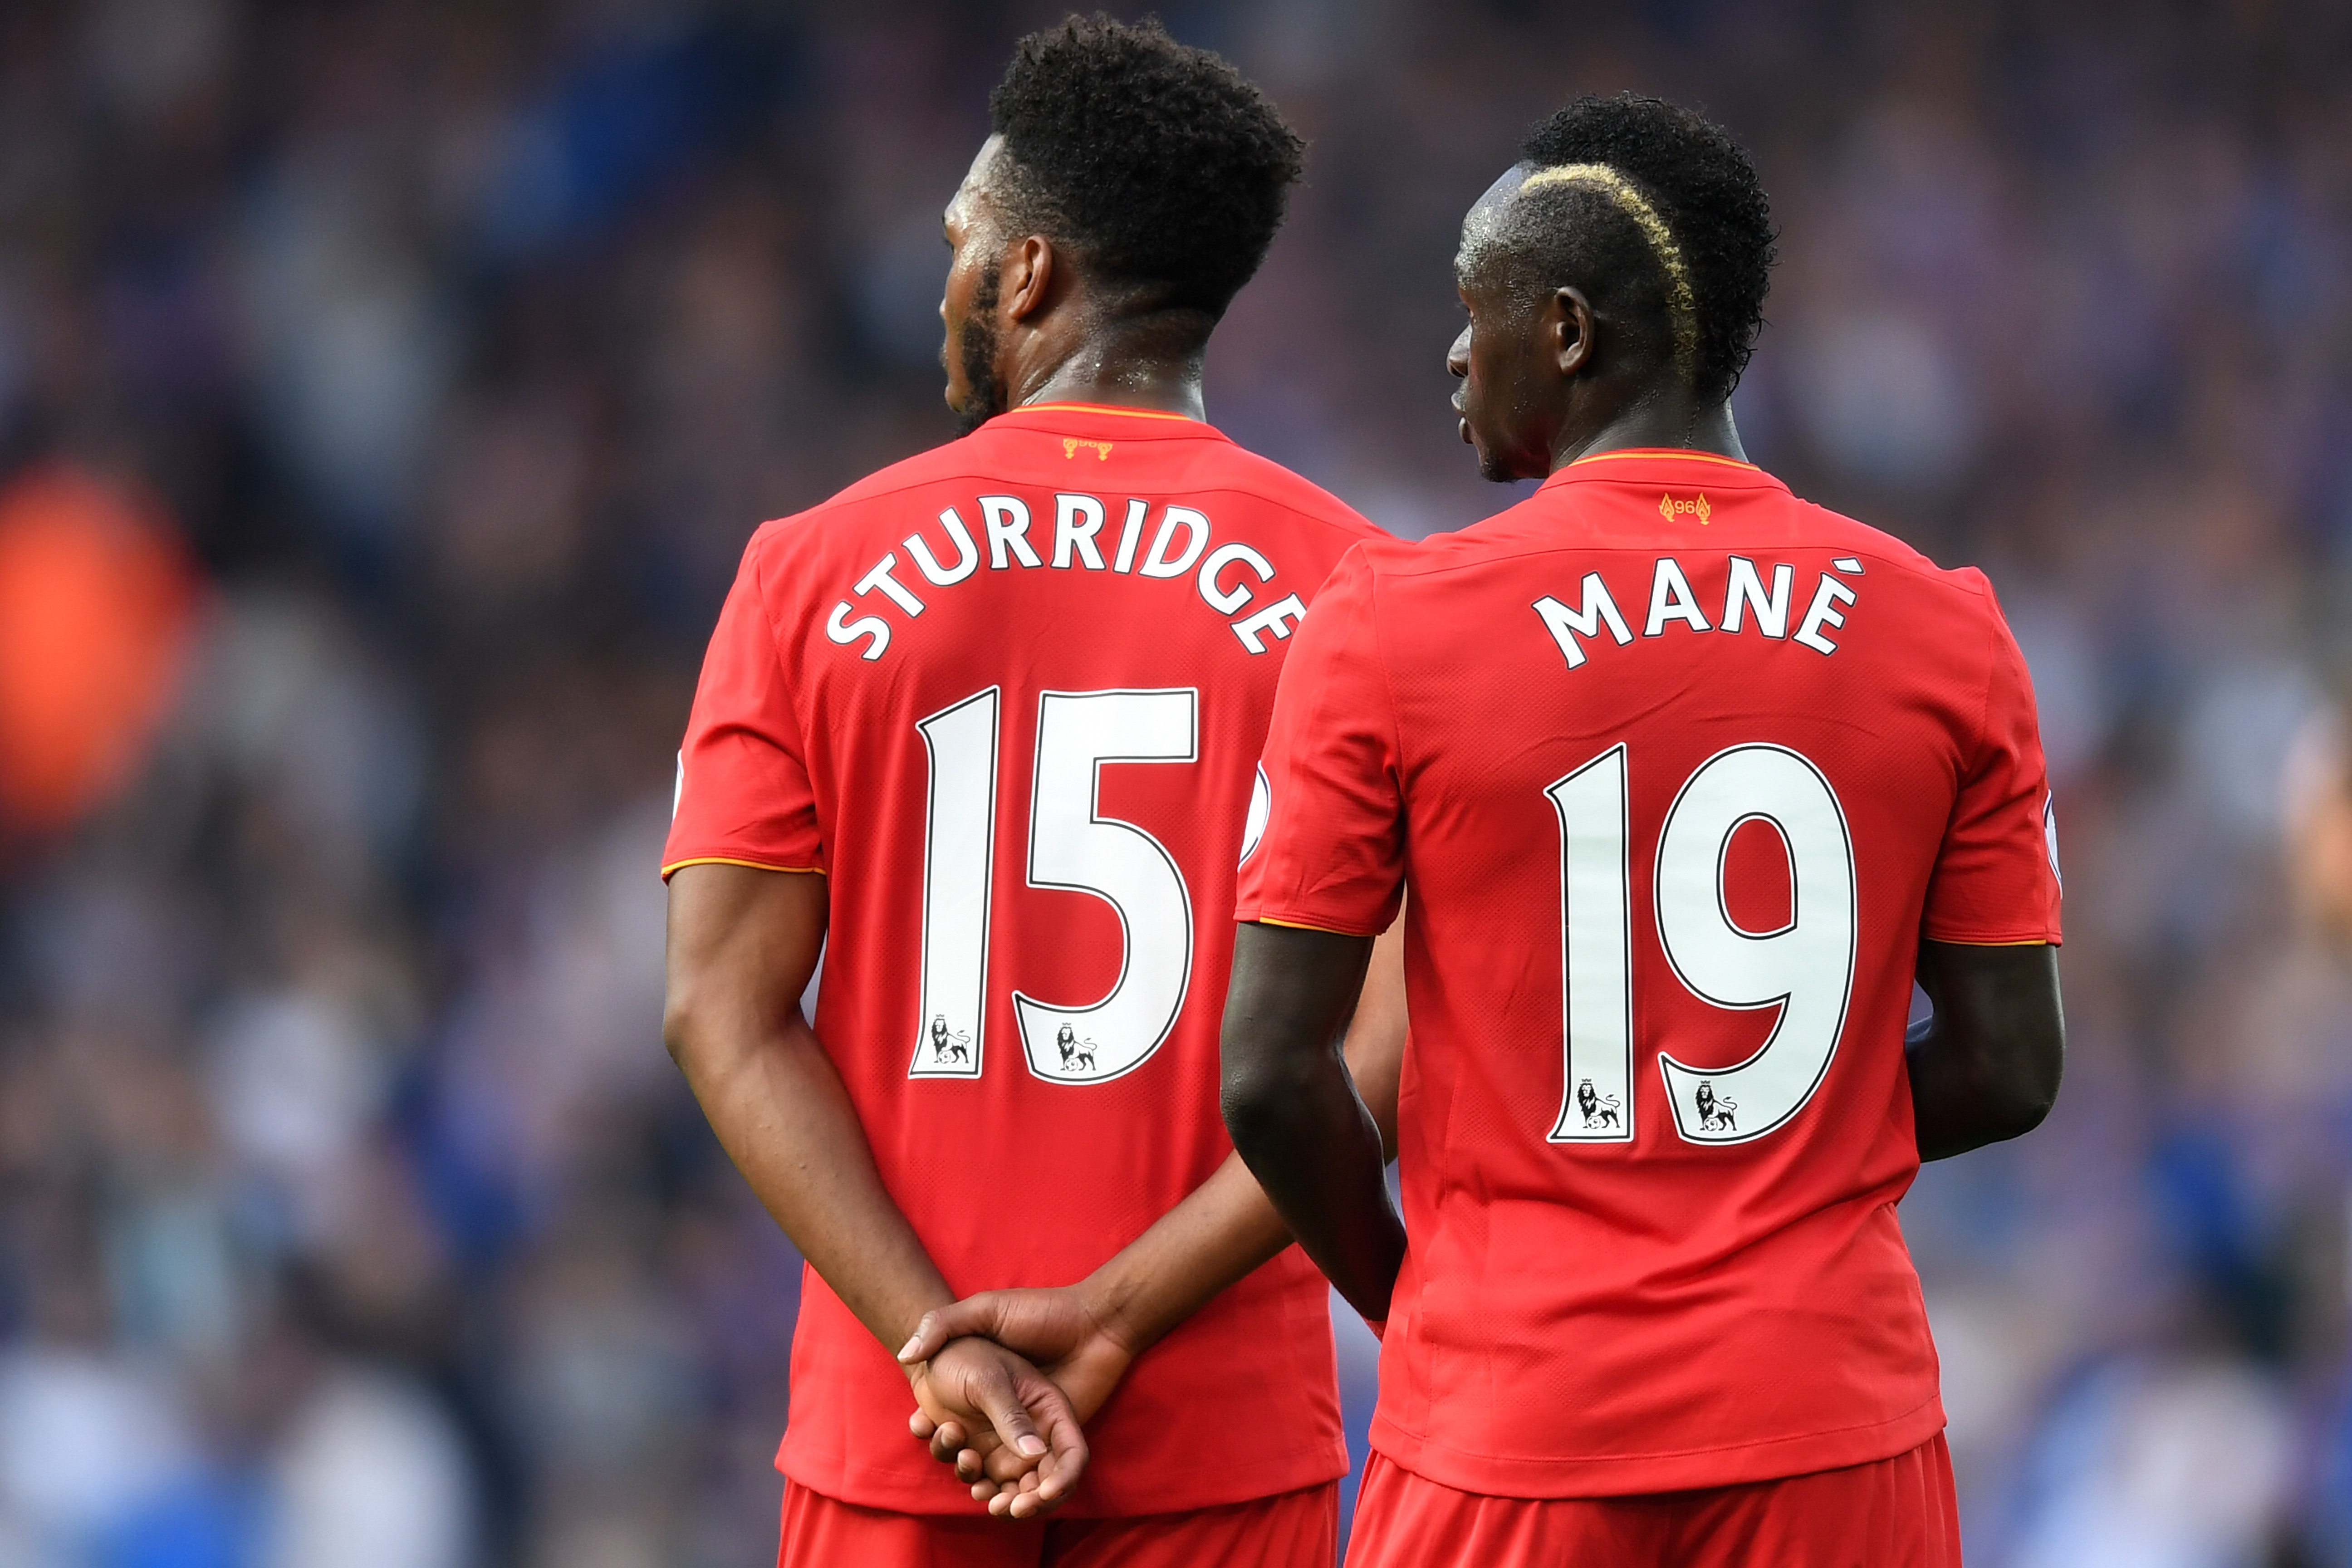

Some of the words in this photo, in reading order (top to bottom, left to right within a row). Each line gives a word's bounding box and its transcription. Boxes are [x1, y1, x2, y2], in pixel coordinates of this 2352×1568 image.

[826, 492, 1308, 662] STURRIDGE
[1675, 500, 1695, 514] 96
[1531, 554, 1866, 670] MANÉ
[907, 684, 1198, 1086] 15
[1543, 741, 1858, 1146] 19
